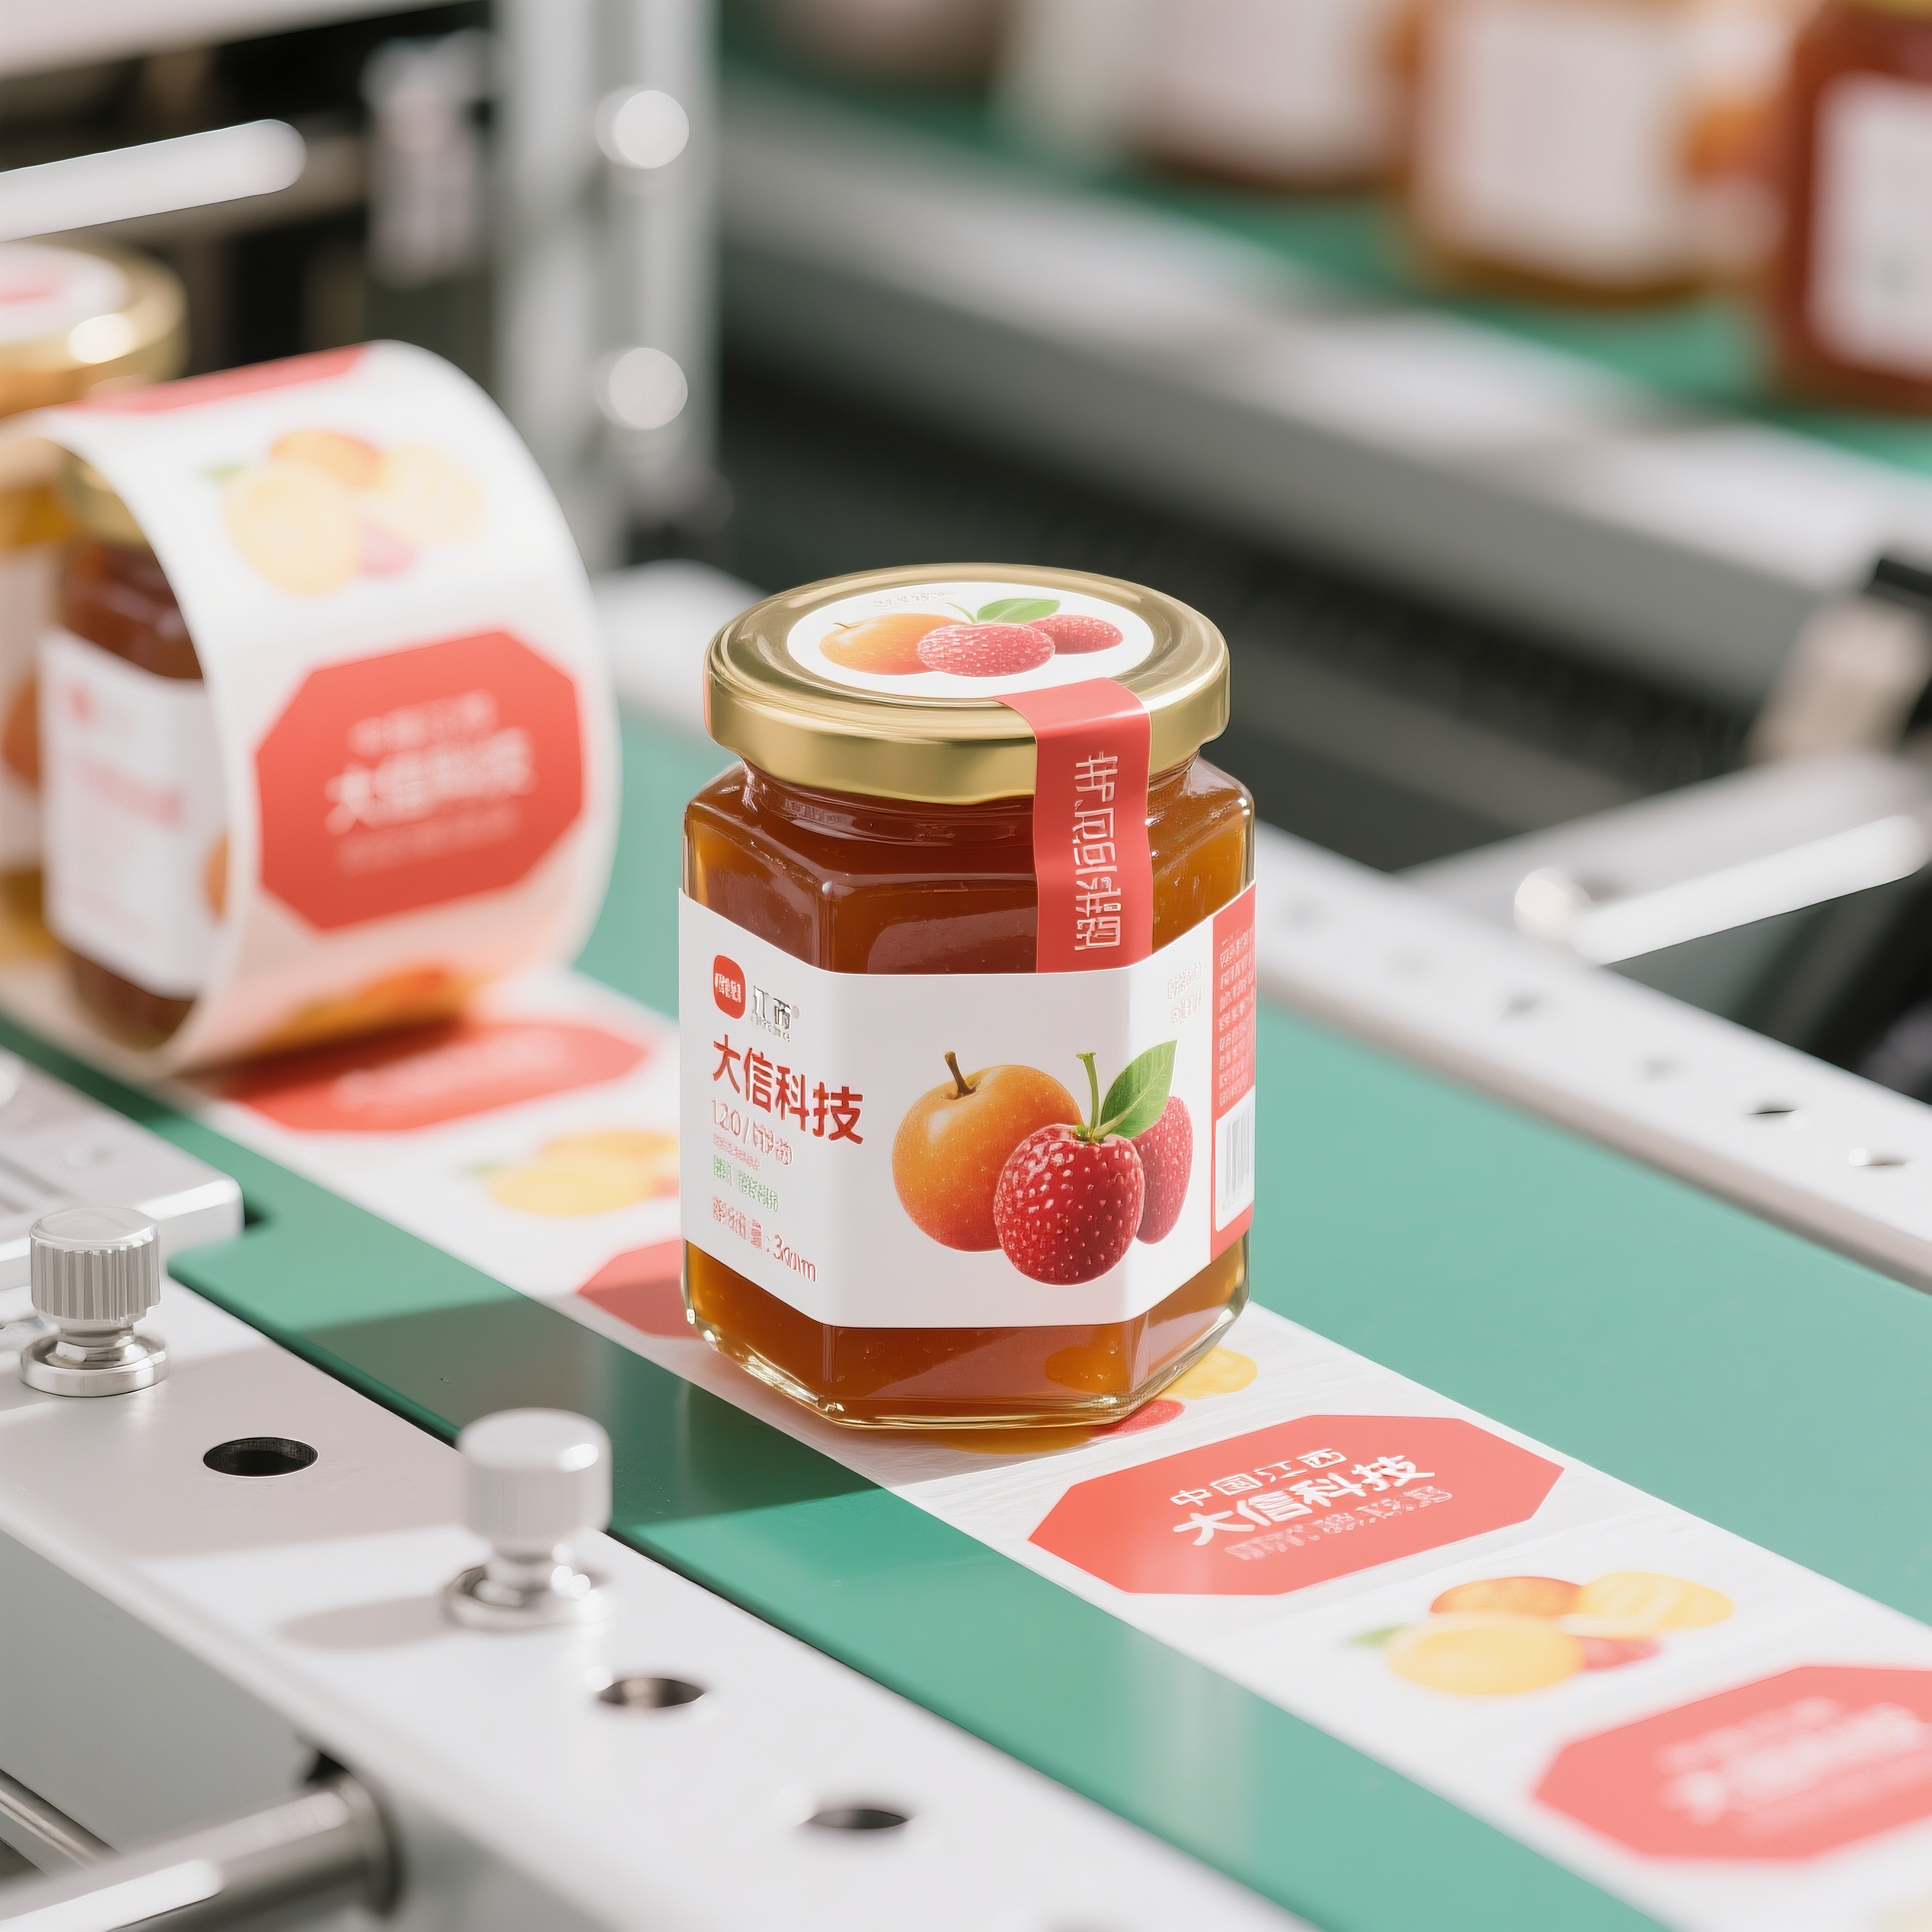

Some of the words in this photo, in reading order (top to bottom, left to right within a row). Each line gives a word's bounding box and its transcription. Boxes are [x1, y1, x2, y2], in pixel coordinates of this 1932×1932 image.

[712, 1034, 864, 1146] 大信科技
[1170, 1448, 1348, 1507] 中国江西
[1173, 1455, 1435, 1546] 大信科技
